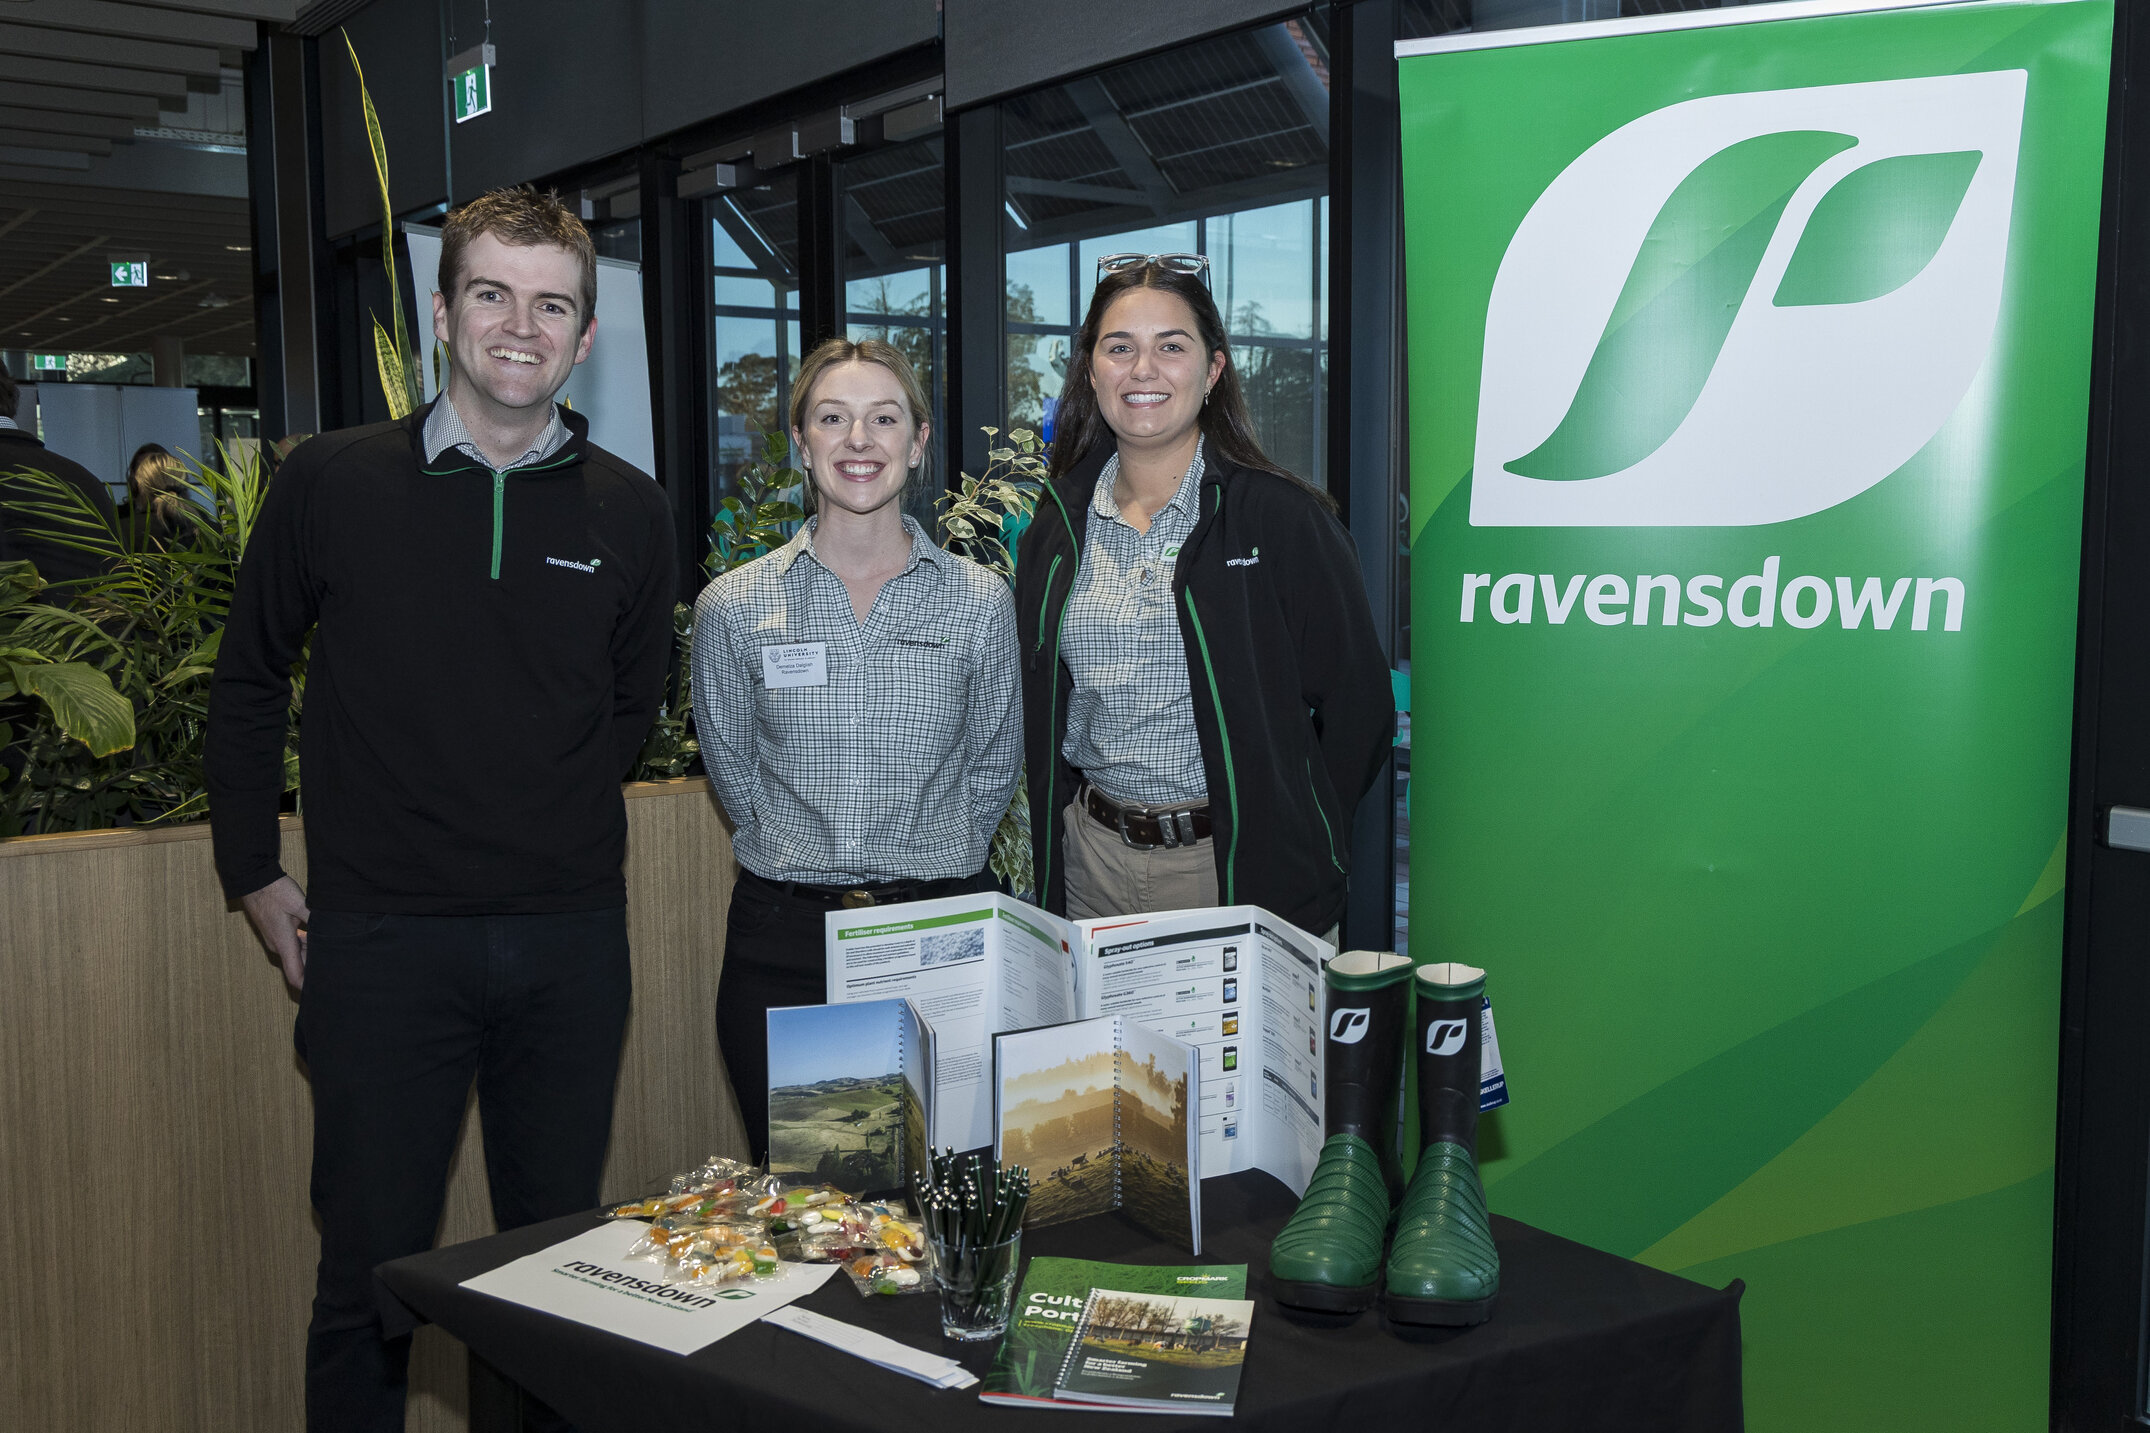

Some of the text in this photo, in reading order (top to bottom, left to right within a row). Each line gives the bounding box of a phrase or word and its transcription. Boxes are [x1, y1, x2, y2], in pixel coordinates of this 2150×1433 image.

[546, 556, 595, 573] ravensdown
[1460, 556, 1966, 632] ravensdown
[845, 924, 914, 938] Fertiliser requirements
[1104, 940, 1155, 955] Spray-out options
[563, 1260, 717, 1309] ravensdown
[1170, 1392, 1221, 1400] ravensdown
